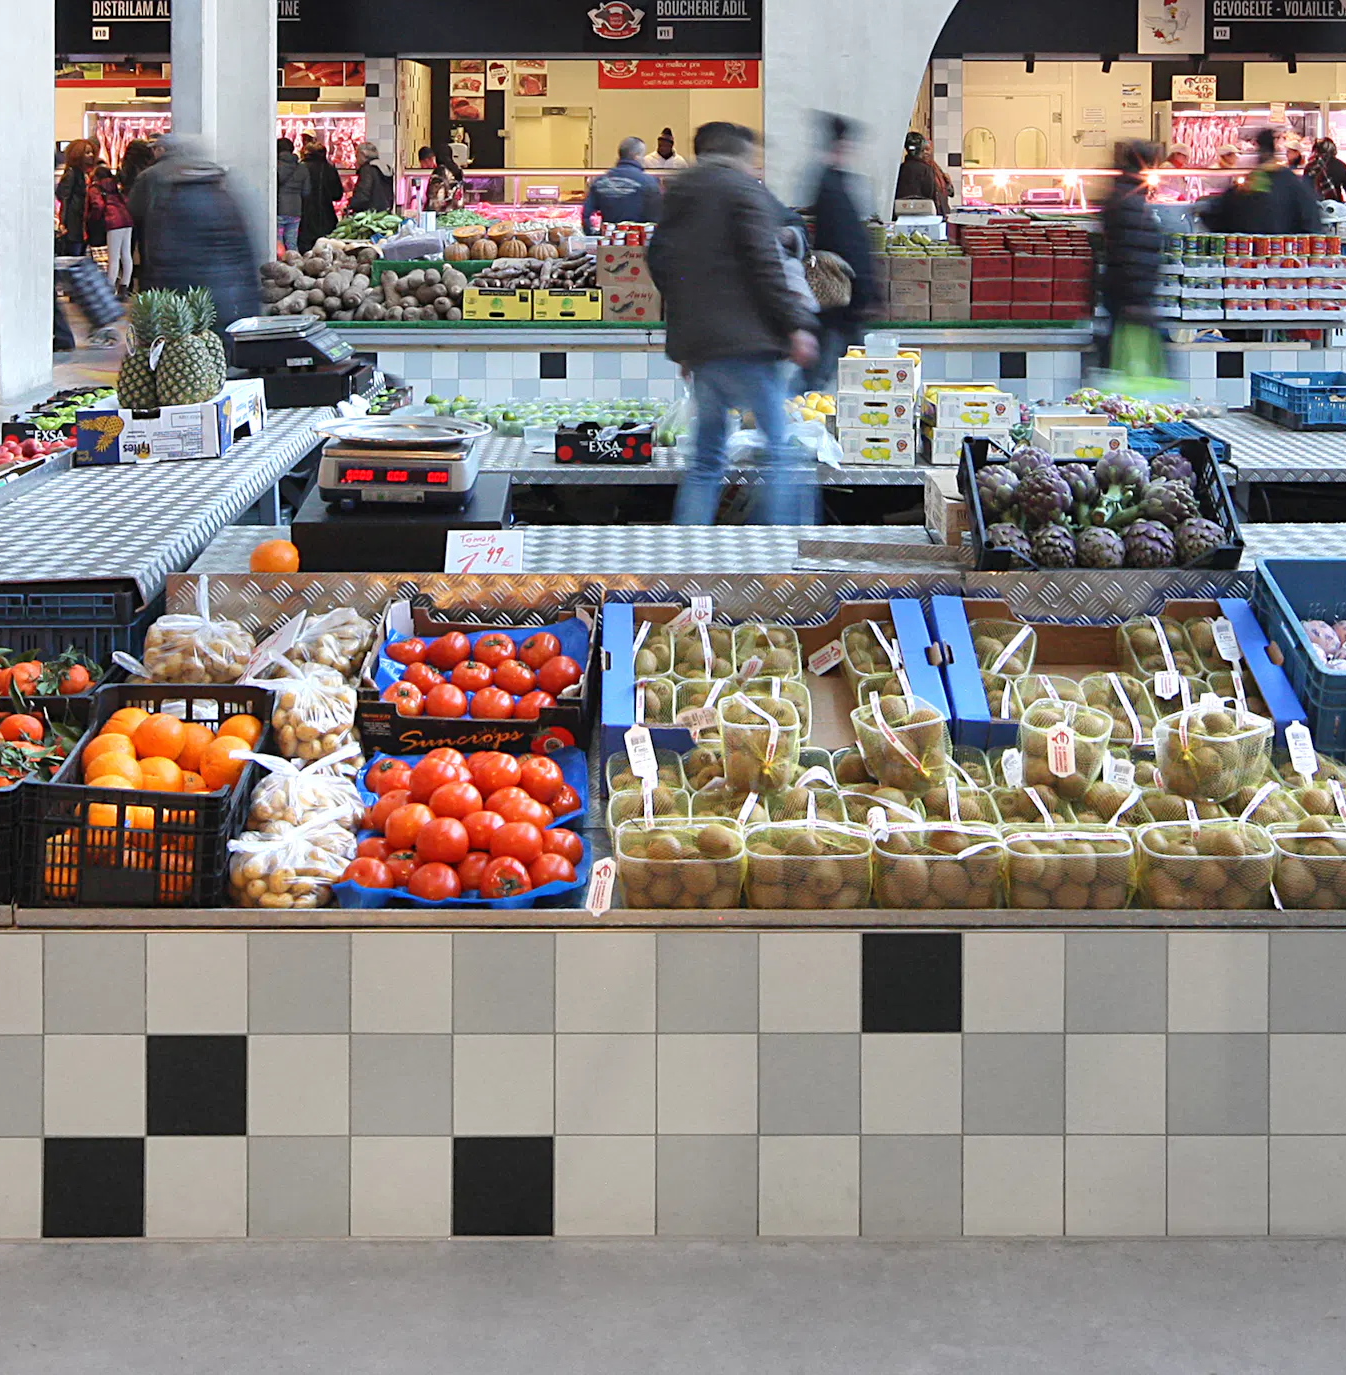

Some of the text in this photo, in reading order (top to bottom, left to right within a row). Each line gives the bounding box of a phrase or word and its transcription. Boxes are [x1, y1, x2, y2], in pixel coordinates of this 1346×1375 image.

[92, 0, 153, 16] DISTRILAM
[657, 0, 748, 16] BOUCHERIE ADIL
[1213, 0, 1273, 16] GEVOGELTE
[1284, 0, 1334, 16] VOLAILLE
[94, 29, 107, 38] V10
[659, 29, 671, 37] V11
[1215, 29, 1227, 37] V12
[34, 430, 65, 443] EXSA
[589, 440, 621, 453] EXSA
[398, 726, 525, 752] Suncrops
